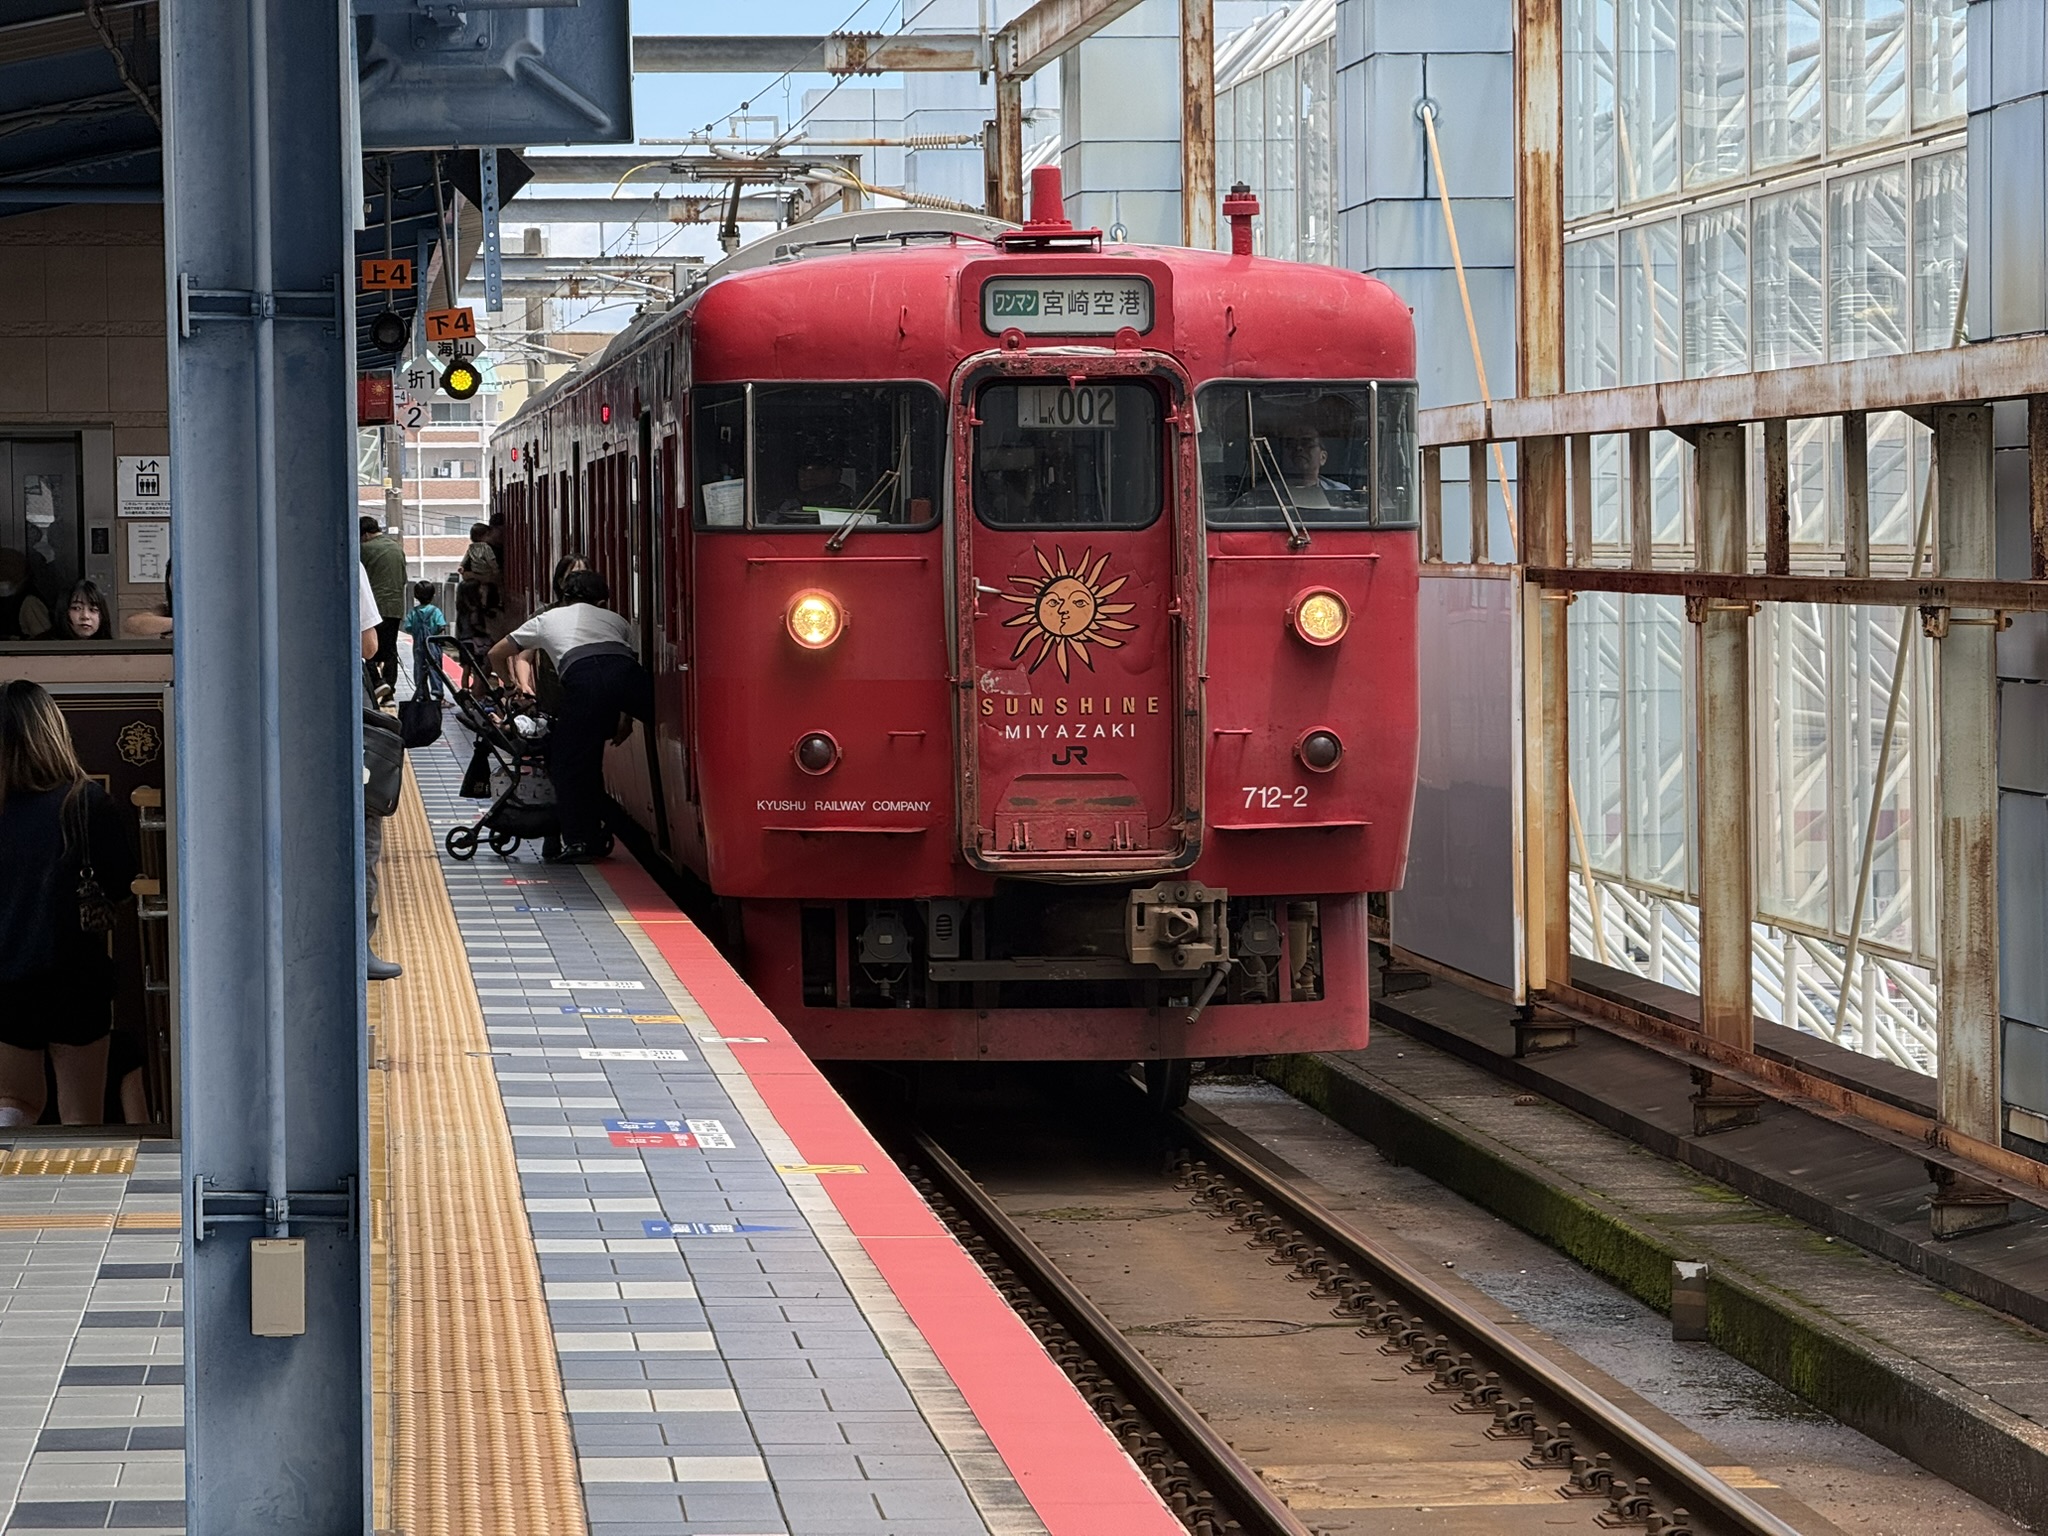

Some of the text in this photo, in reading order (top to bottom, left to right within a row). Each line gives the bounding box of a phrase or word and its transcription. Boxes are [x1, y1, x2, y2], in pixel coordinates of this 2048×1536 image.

[366, 264, 407, 285] 上4
[995, 289, 1140, 316] ワンマン 宮崎空港
[428, 312, 471, 336] 下4
[408, 369, 436, 390] 折1
[407, 406, 422, 428] 2
[980, 696, 1159, 716] SUNSHINE
[1005, 723, 1135, 739] MIYAZAKI
[1052, 745, 1088, 766] JR
[756, 800, 931, 812] KYUSHU RAILWAY COMPANY
[1242, 785, 1308, 809] 712-2
